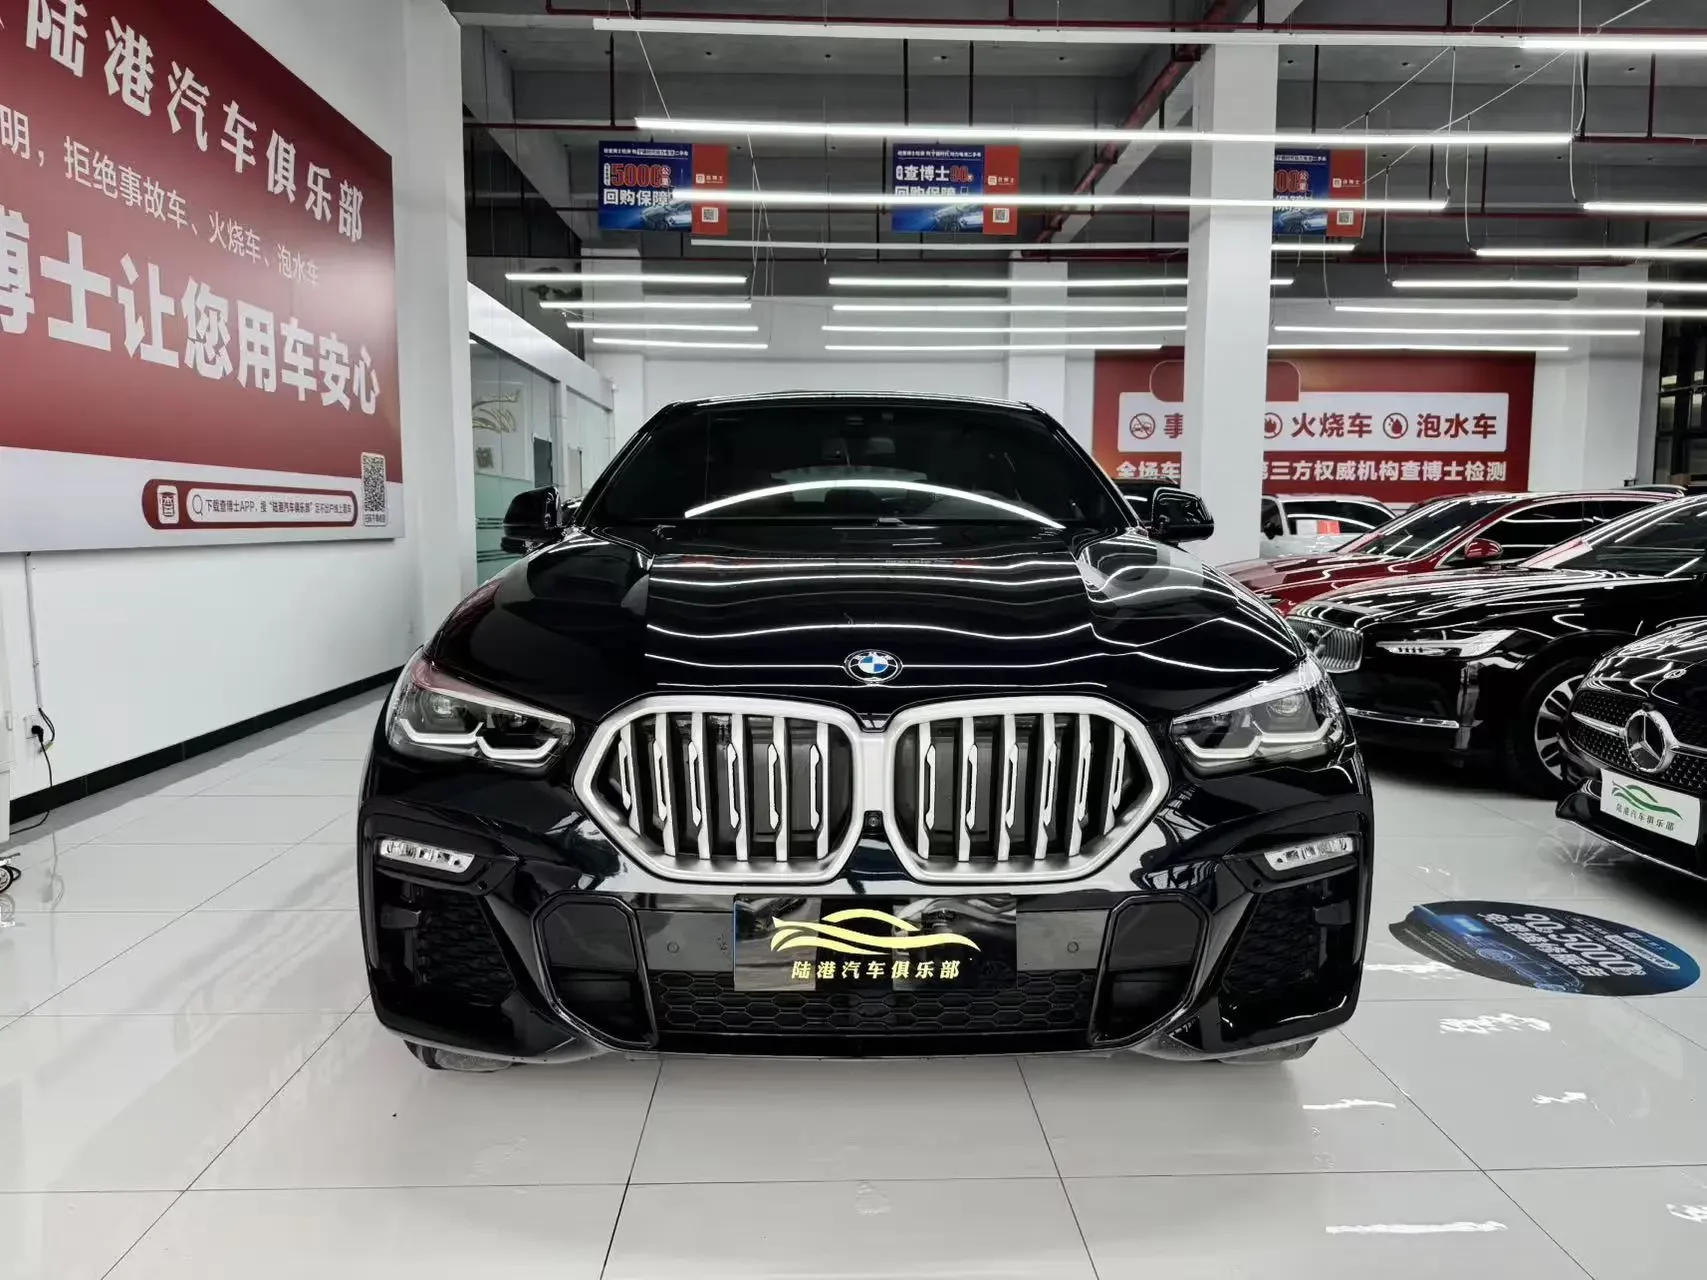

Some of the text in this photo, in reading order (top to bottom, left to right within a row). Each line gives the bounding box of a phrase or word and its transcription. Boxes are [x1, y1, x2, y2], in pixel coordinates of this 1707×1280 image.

[1292, 413, 1373, 437] 火烧车
[1416, 413, 1497, 439] 泡水车
[791, 960, 960, 979] 陆港汽车俱乐部
